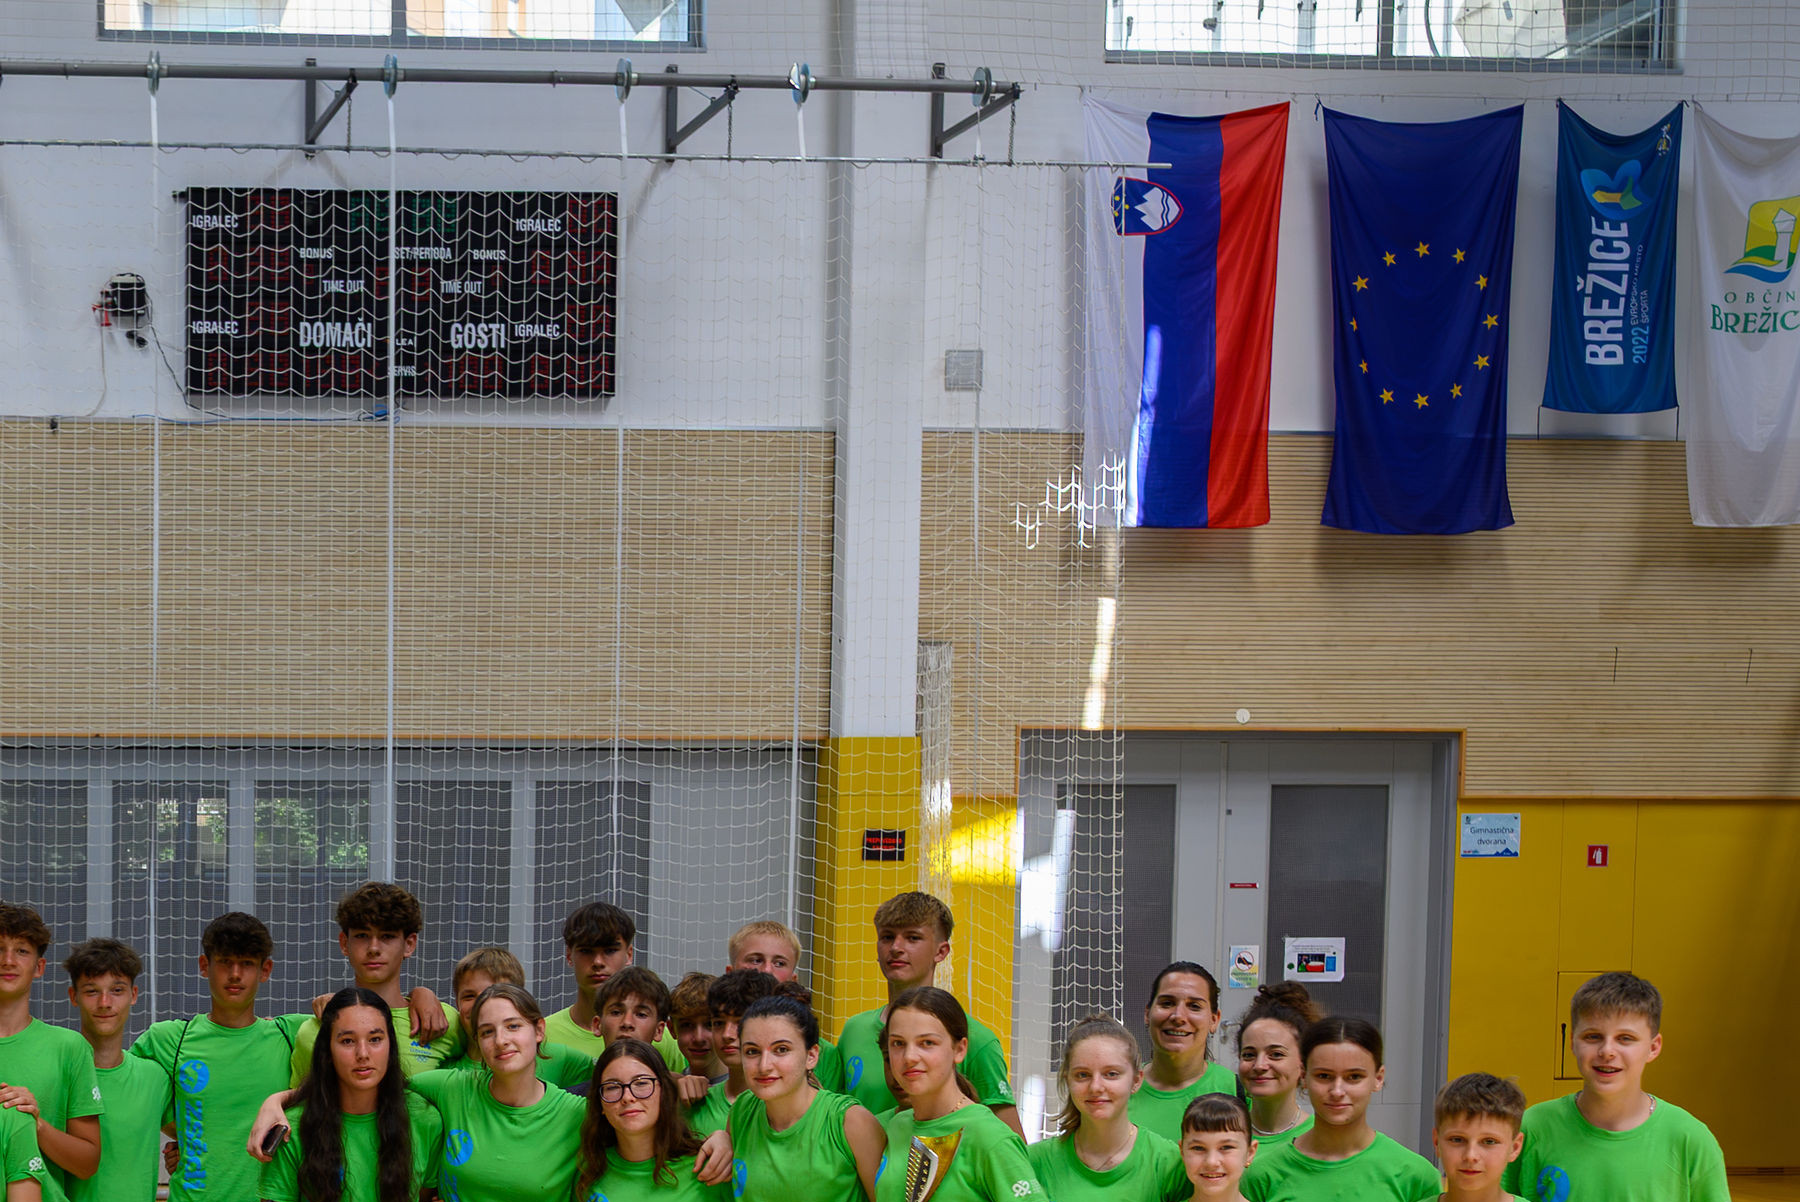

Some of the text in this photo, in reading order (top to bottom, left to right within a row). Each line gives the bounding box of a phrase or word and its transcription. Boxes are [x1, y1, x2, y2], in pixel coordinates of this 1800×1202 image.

[192, 214, 239, 228] IGRALEC
[515, 218, 561, 232] IGRALEC
[300, 247, 333, 259] BONUS
[473, 249, 506, 261] BONUS
[322, 280, 365, 292] TIME OUT
[440, 281, 482, 293] TIME OUT
[1577, 216, 1630, 366] BREŽICE
[1724, 289, 1796, 304] OBČIN
[1640, 290, 1650, 324] ŠPORTA
[1710, 304, 1800, 333] BREŽIC
[192, 321, 239, 334] IGRALEC
[300, 317, 372, 347] DOMAČI
[514, 324, 560, 337] IGRALEC
[450, 323, 505, 349] GOSTI
[1632, 326, 1650, 363] 2022
[1470, 826, 1514, 834] Gimnastična
